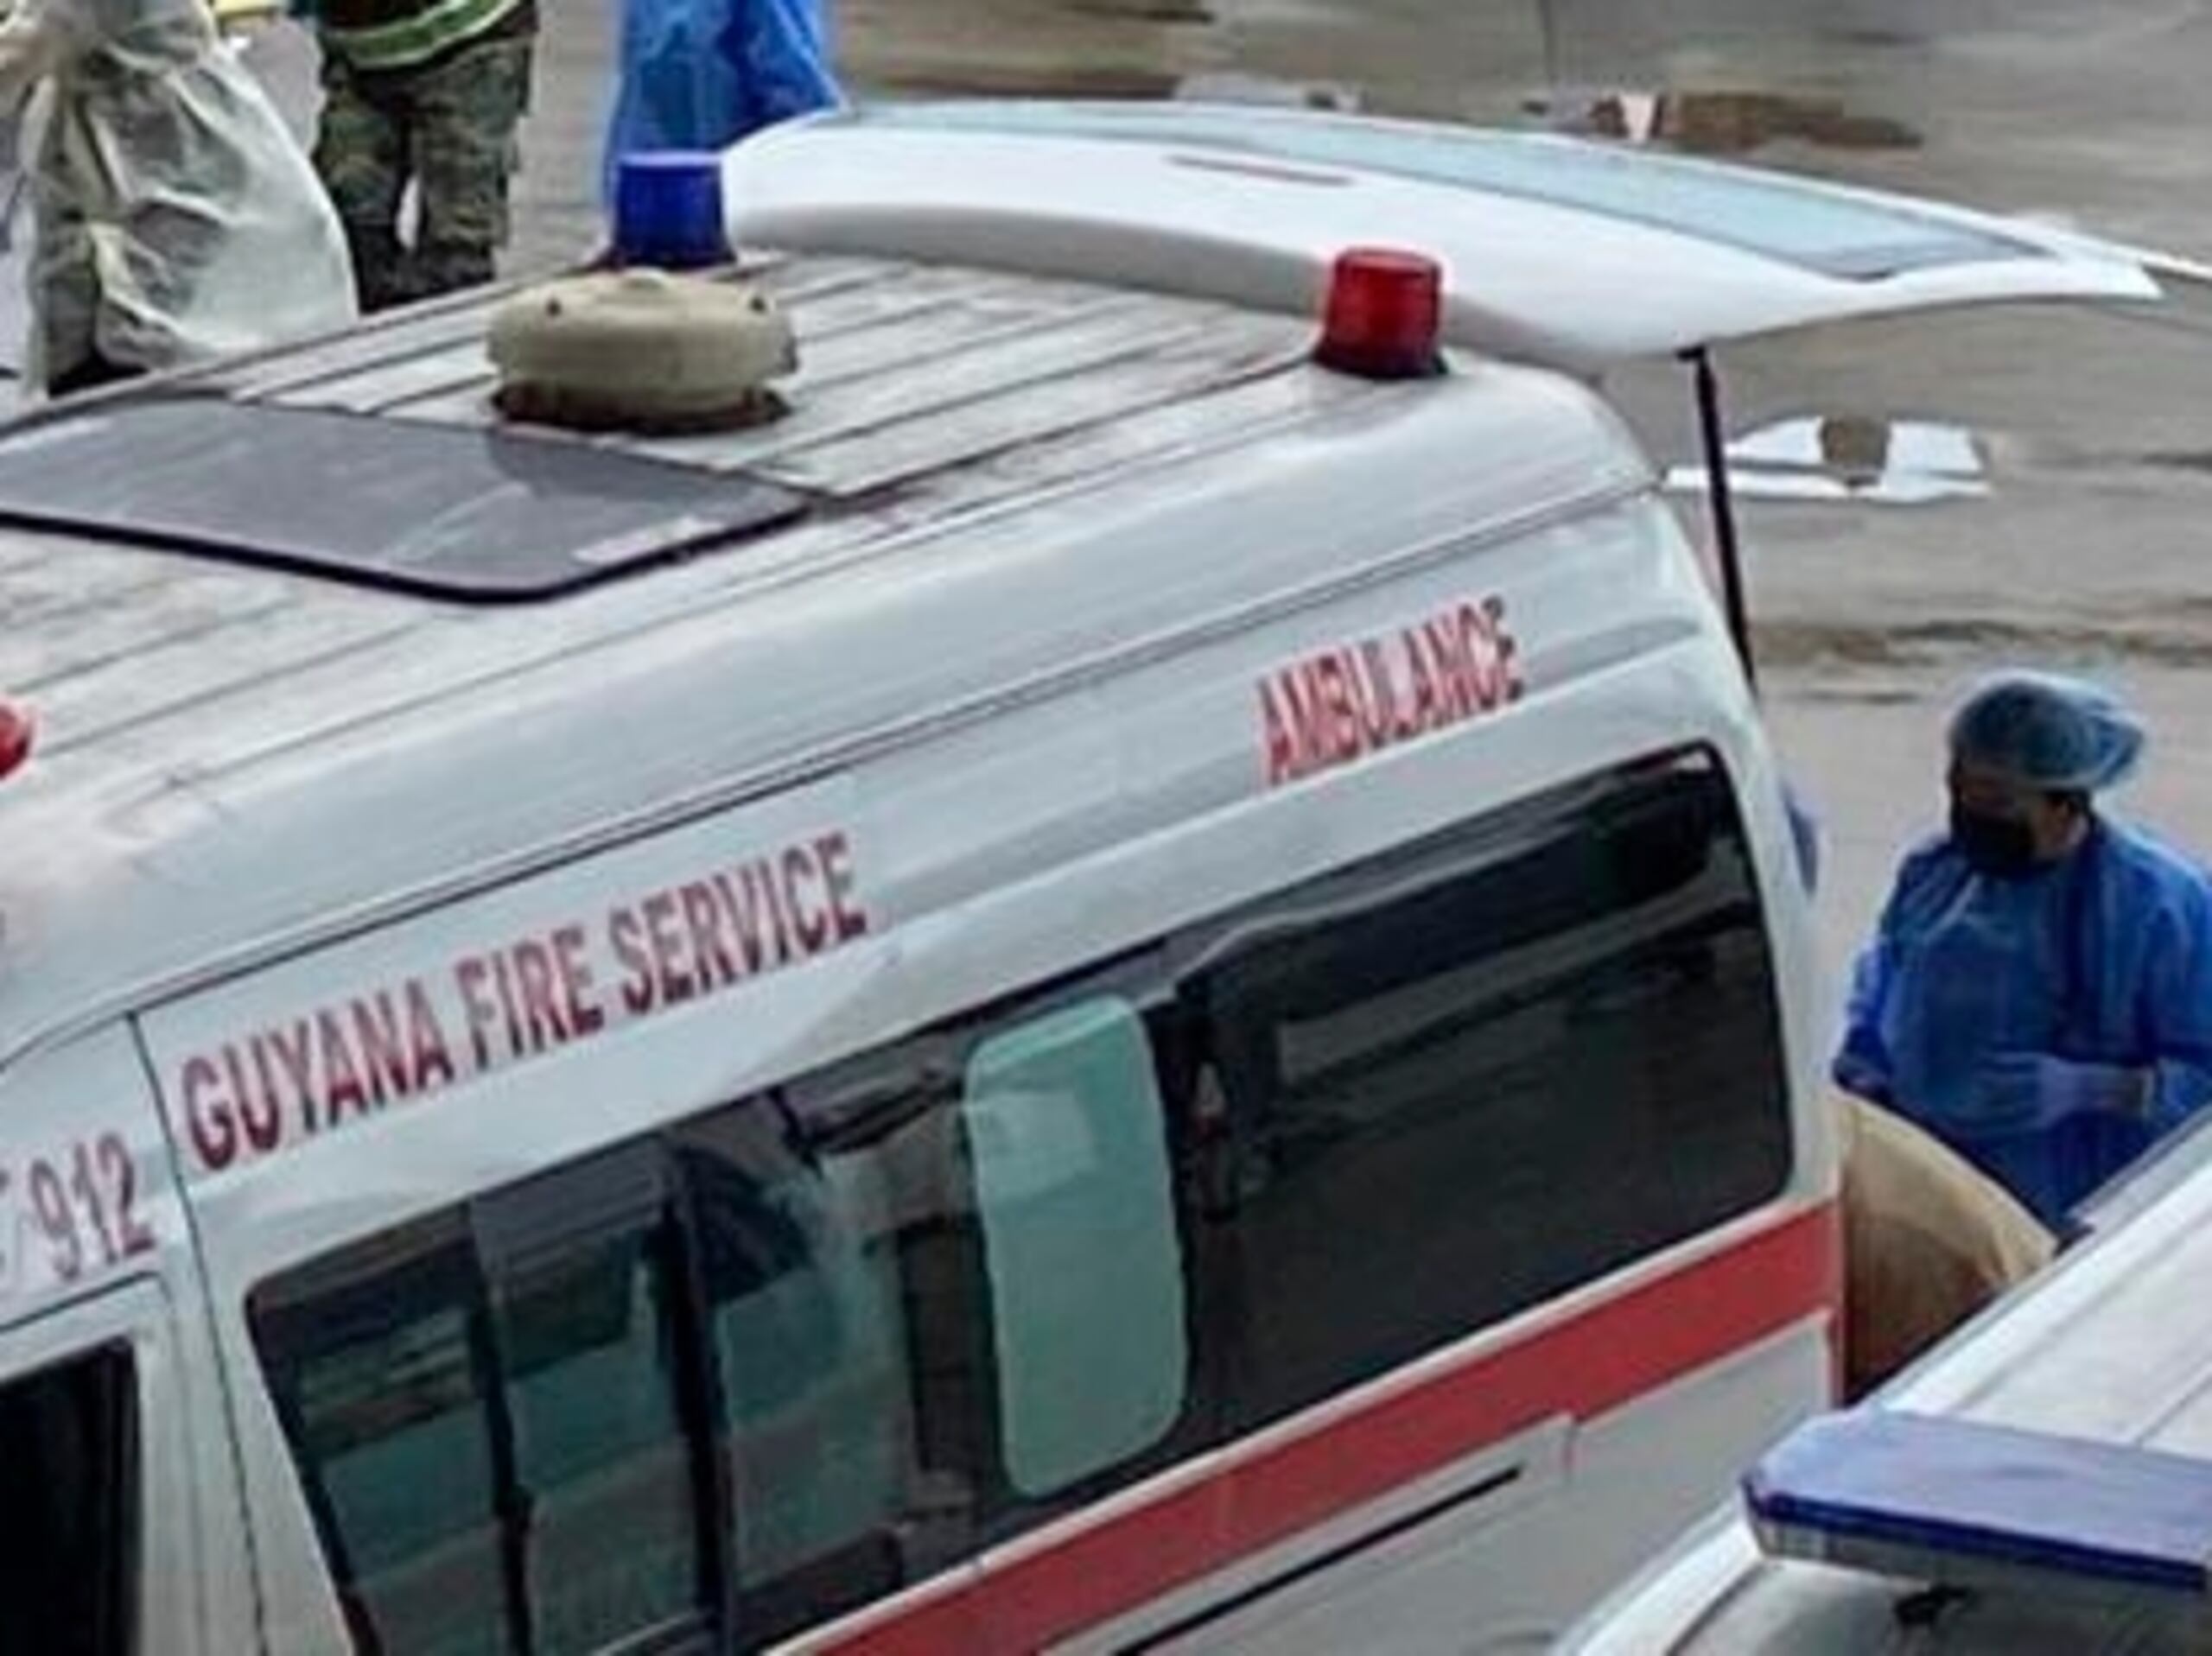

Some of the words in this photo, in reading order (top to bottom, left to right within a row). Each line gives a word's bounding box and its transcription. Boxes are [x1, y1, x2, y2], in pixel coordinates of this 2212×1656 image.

[1256, 594, 1524, 787] AMBULANCE
[181, 980, 454, 1170] GUYANA
[456, 922, 605, 1069] FIRE
[610, 831, 867, 1014] SERVICE
[29, 1133, 156, 1280] 912
